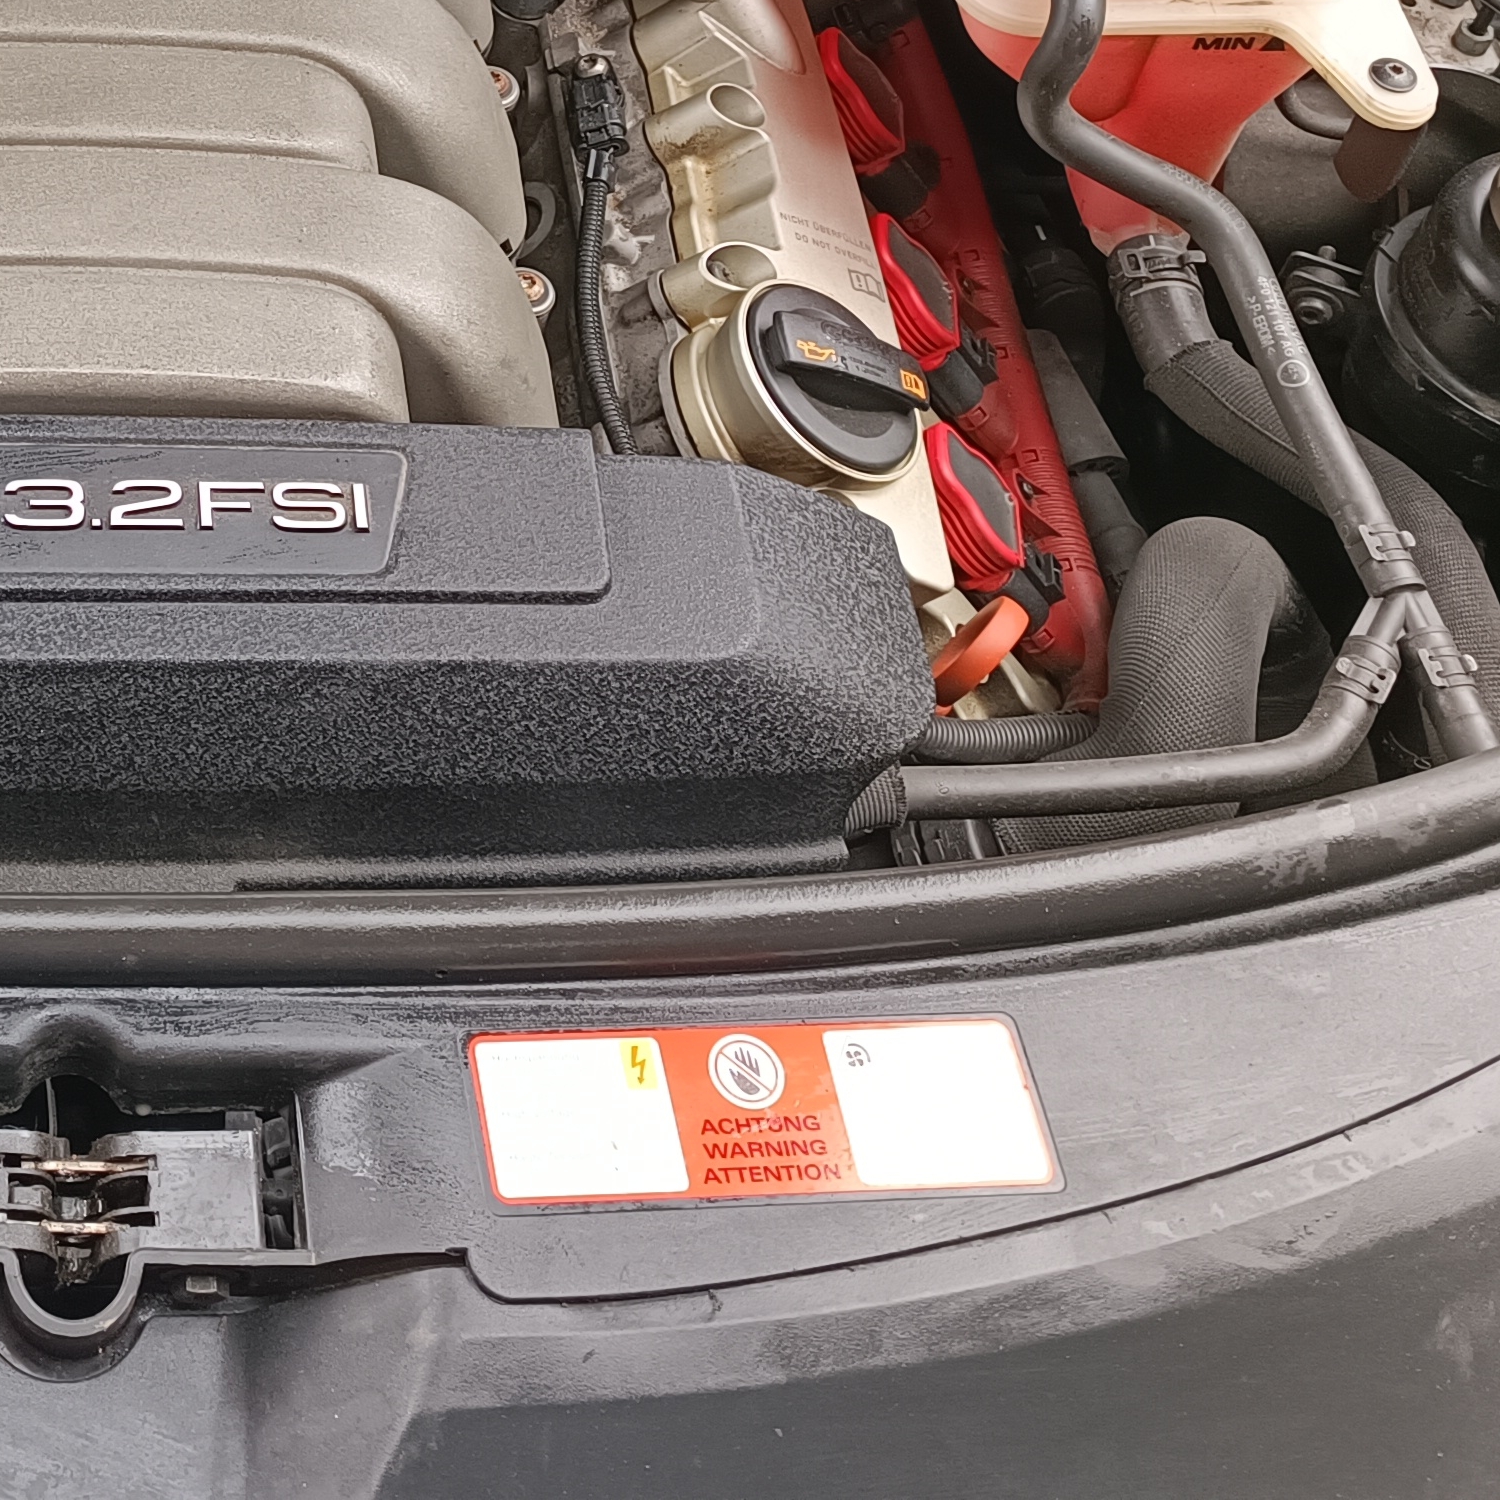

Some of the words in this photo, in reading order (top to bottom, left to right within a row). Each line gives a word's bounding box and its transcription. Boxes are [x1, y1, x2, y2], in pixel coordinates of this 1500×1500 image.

[1192, 36, 1256, 51] MIN
[780, 212, 809, 228] NICHT
[794, 231, 808, 244] DO
[812, 238, 830, 251] NOT
[701, 1115, 821, 1135] ACHTUNG
[703, 1140, 827, 1159] WARNING
[704, 1164, 841, 1184] ATTENTION
